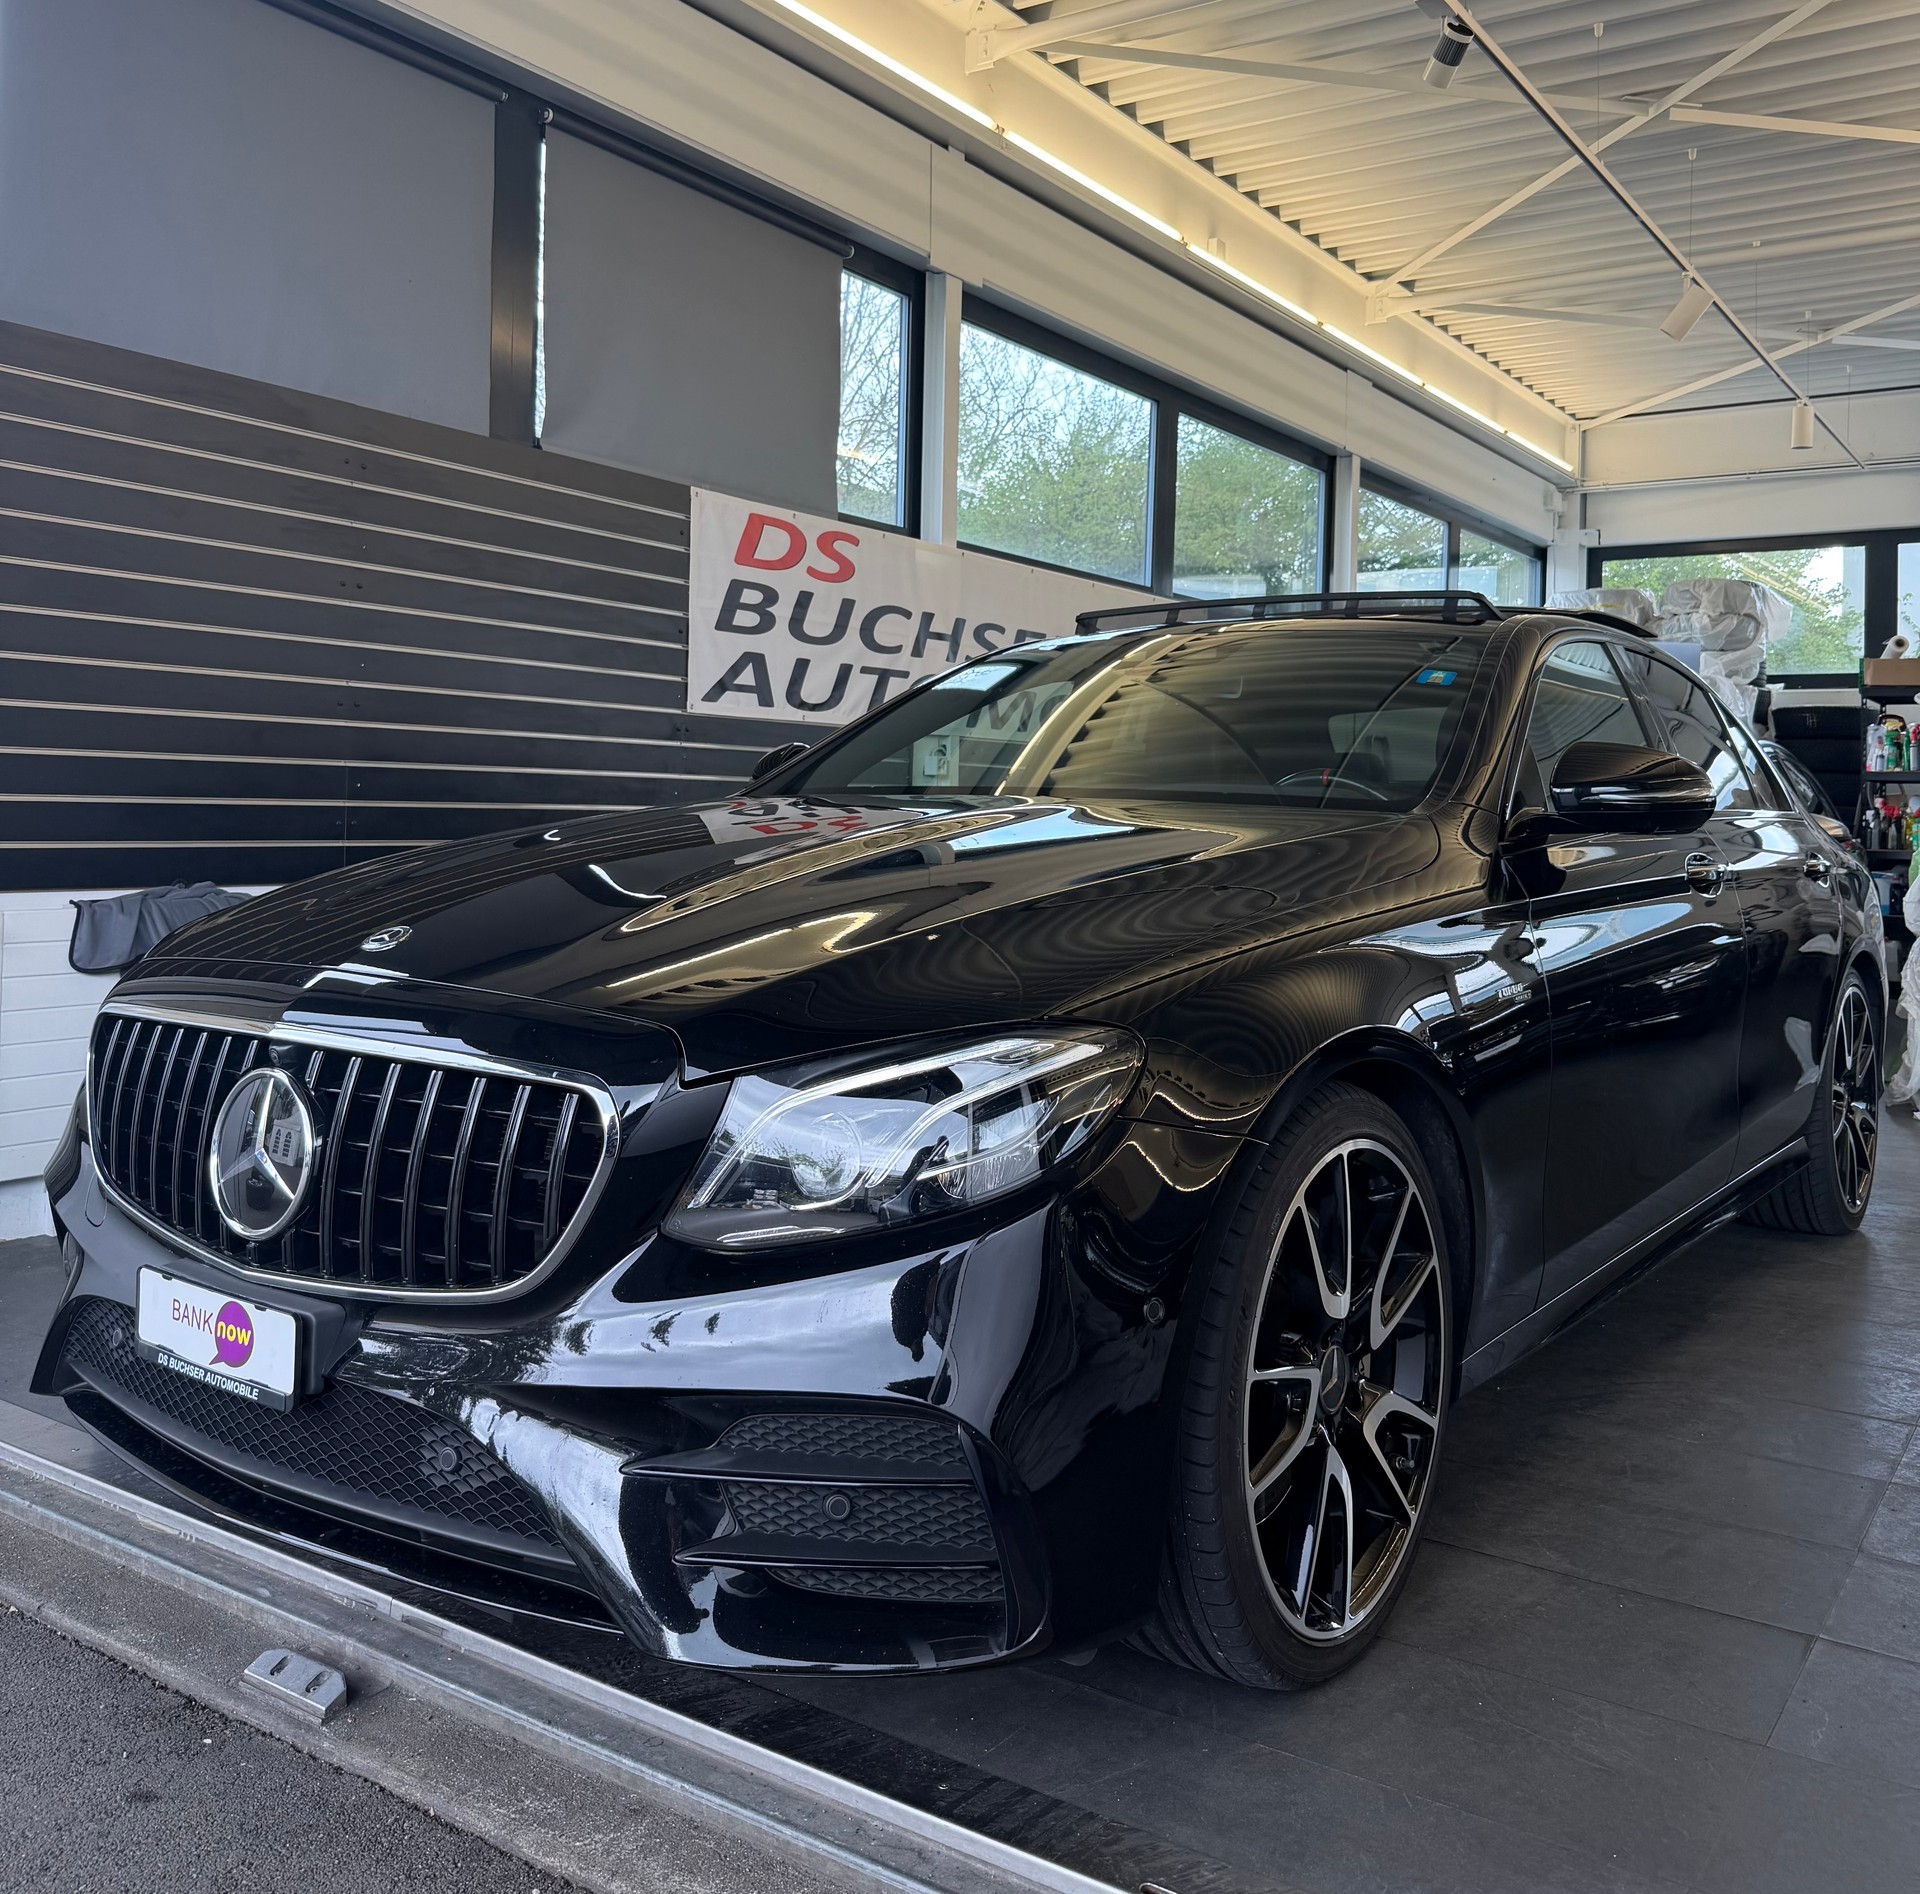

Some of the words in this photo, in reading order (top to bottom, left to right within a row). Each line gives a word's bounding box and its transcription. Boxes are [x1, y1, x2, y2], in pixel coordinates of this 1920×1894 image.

[734, 512, 860, 583] DS
[171, 1298, 214, 1335] BANK
[216, 1320, 252, 1346] now
[158, 1352, 169, 1366] DS
[169, 1354, 205, 1381] BUCHSER
[204, 1372, 259, 1401] AUTOMOBILE
